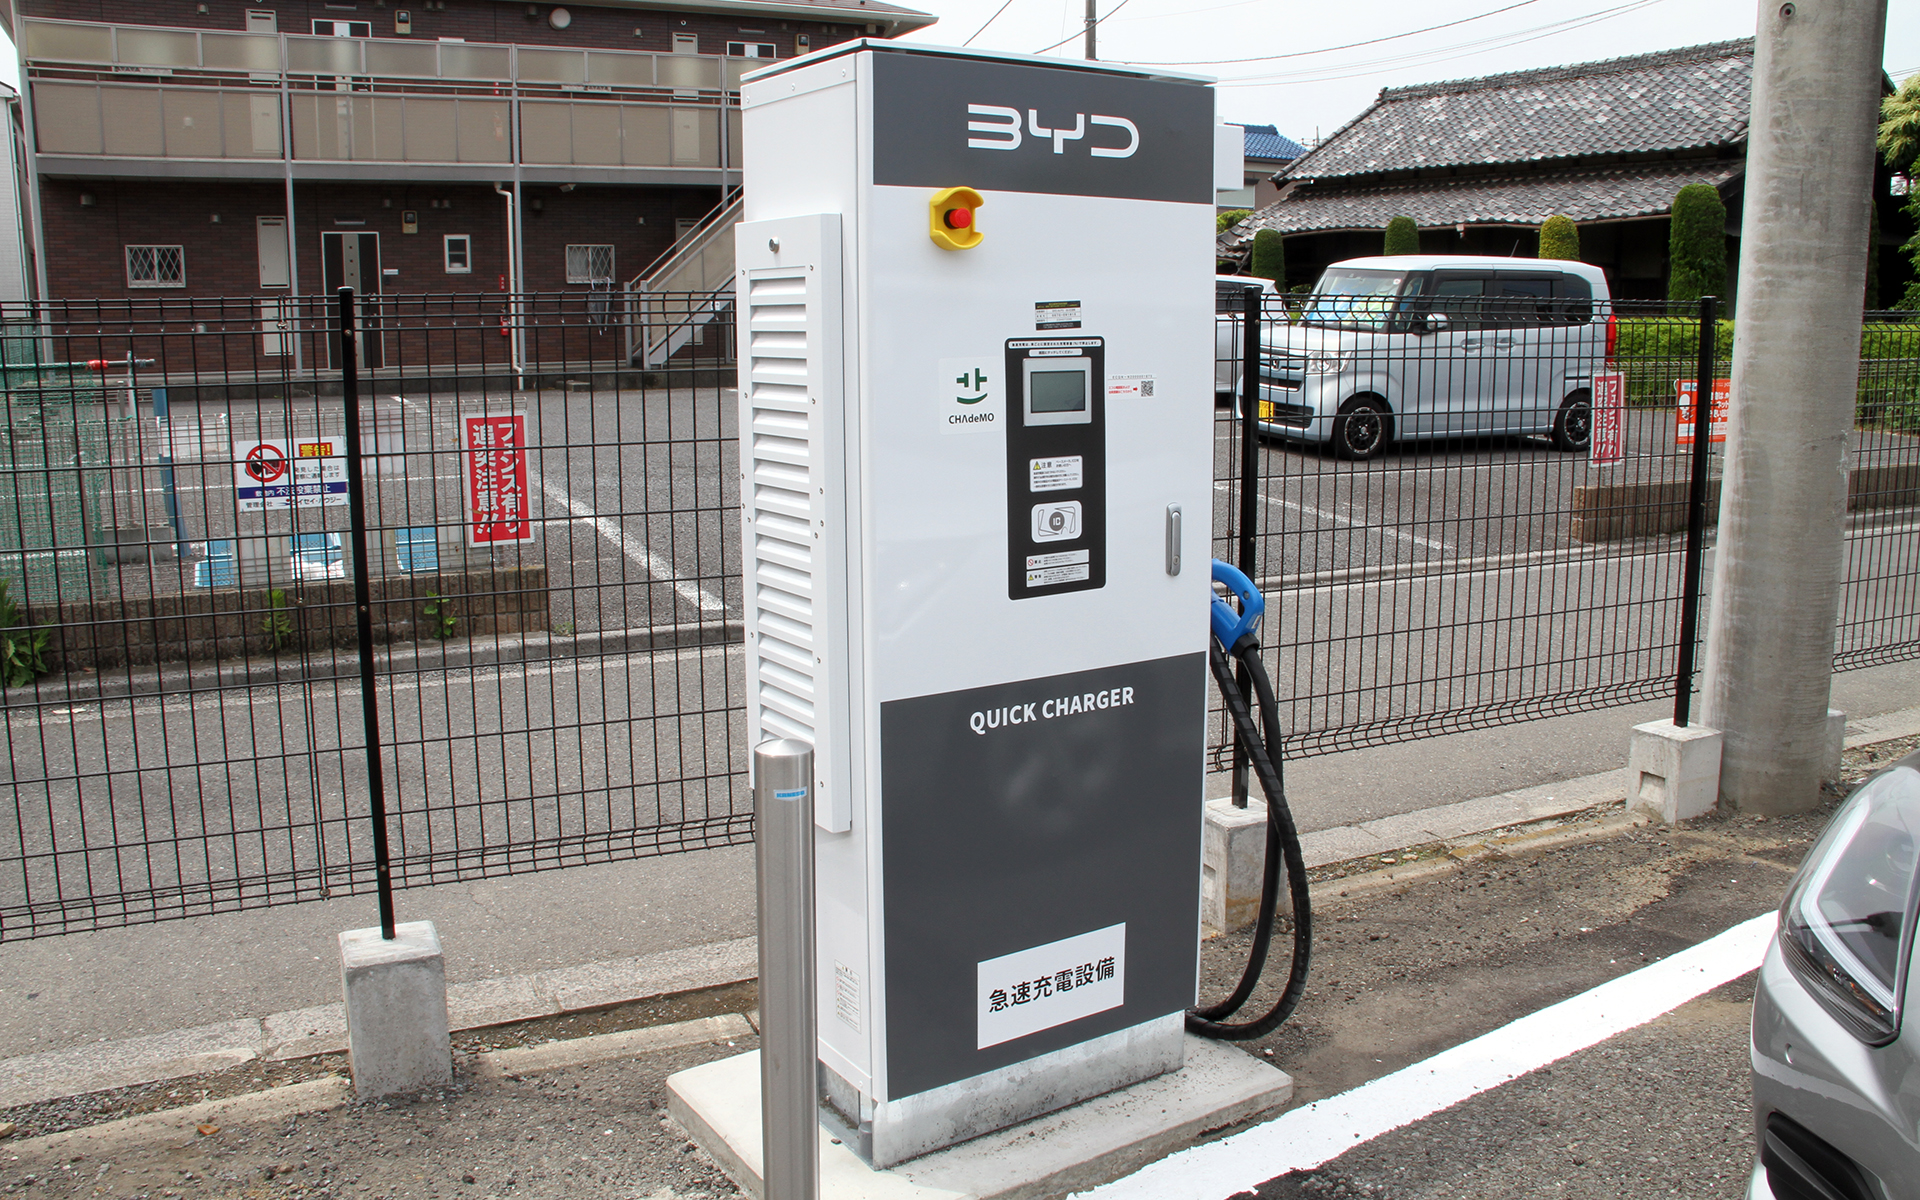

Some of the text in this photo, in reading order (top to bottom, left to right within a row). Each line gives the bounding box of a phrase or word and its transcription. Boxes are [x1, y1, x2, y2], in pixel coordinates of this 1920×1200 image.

[967, 103, 1140, 159] BYD
[948, 412, 995, 425] CHAdeMO
[970, 686, 1134, 735] QUICK CHARGER
[989, 956, 1115, 1013] 急速充電設備
